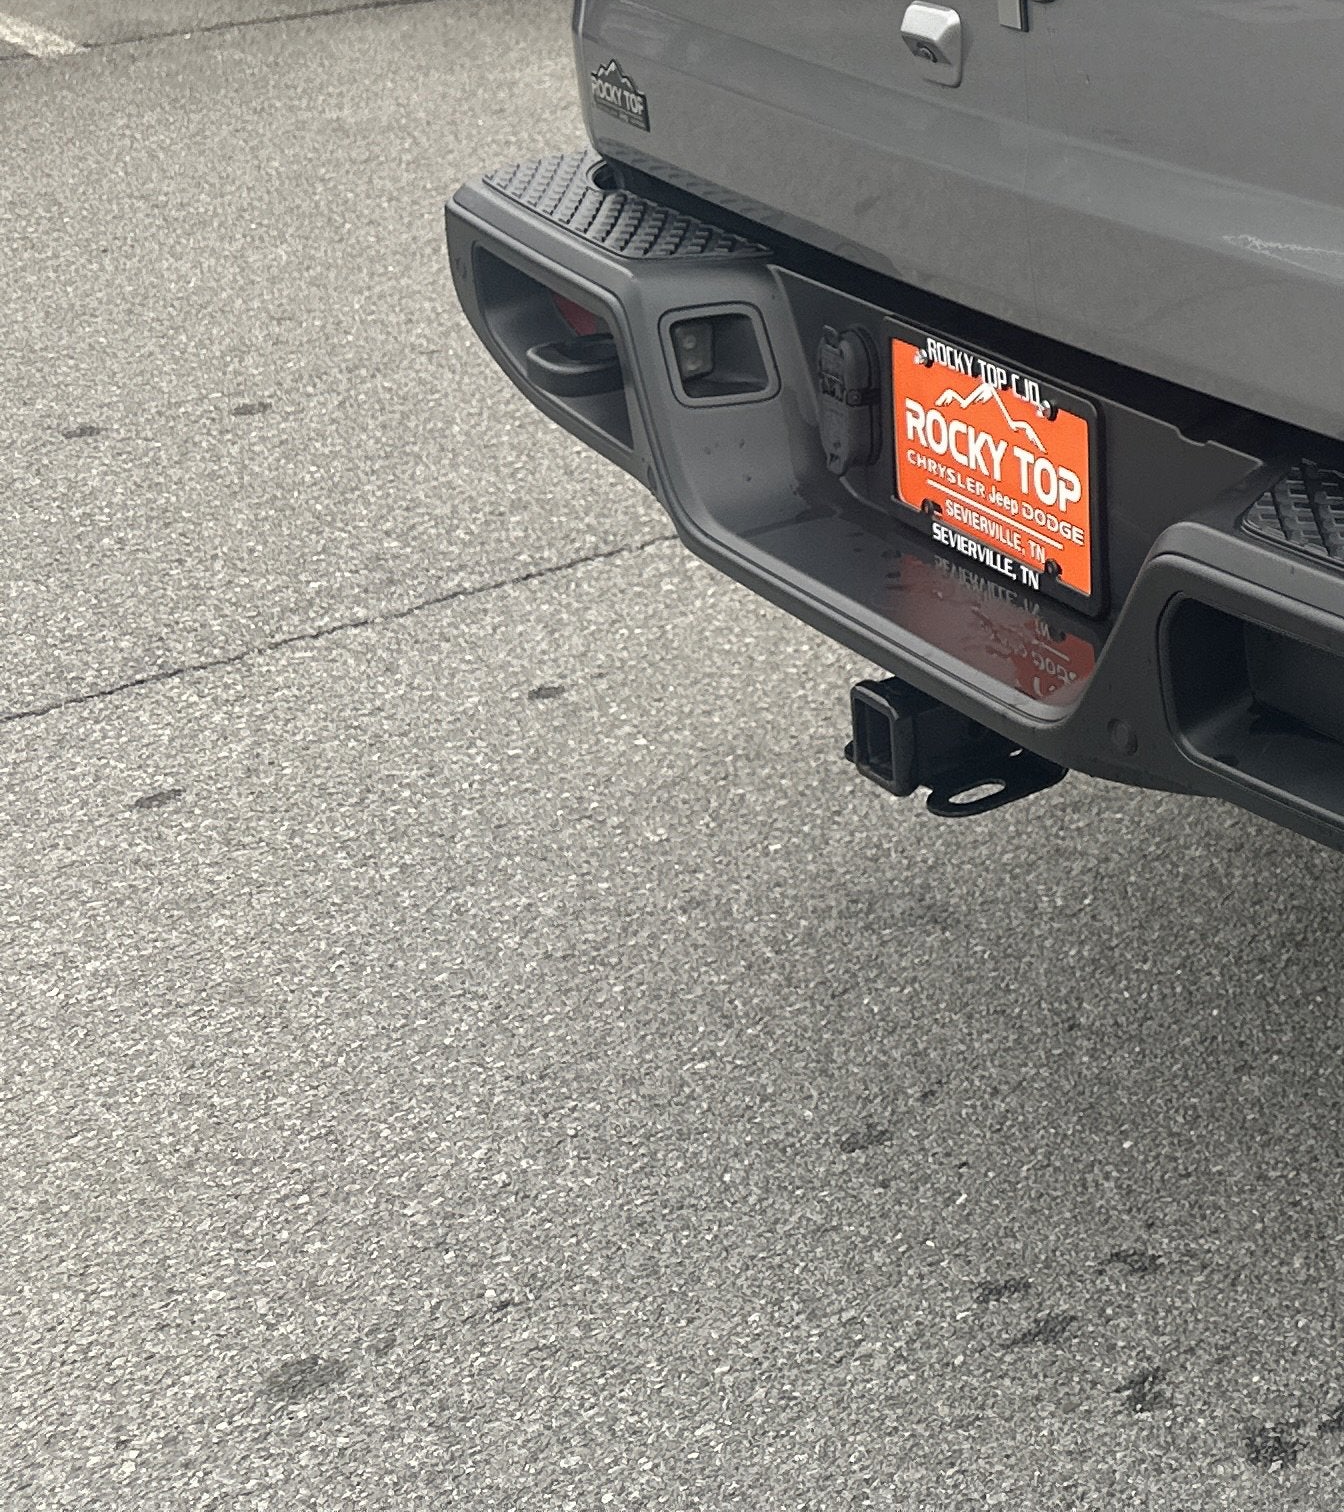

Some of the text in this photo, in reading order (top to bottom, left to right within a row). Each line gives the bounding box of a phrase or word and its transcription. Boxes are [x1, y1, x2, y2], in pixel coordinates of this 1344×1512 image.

[927, 338, 974, 375] ROCKY
[978, 359, 1007, 389] TOP
[905, 398, 1082, 513] ROCKY TOP
[907, 449, 1085, 546] CHRYSLER Jeep DODGE
[932, 523, 1017, 580] SEVIERVILLE,
[1020, 565, 1040, 590] TN
[946, 499, 1046, 564] SEVIERVILLE, TN
